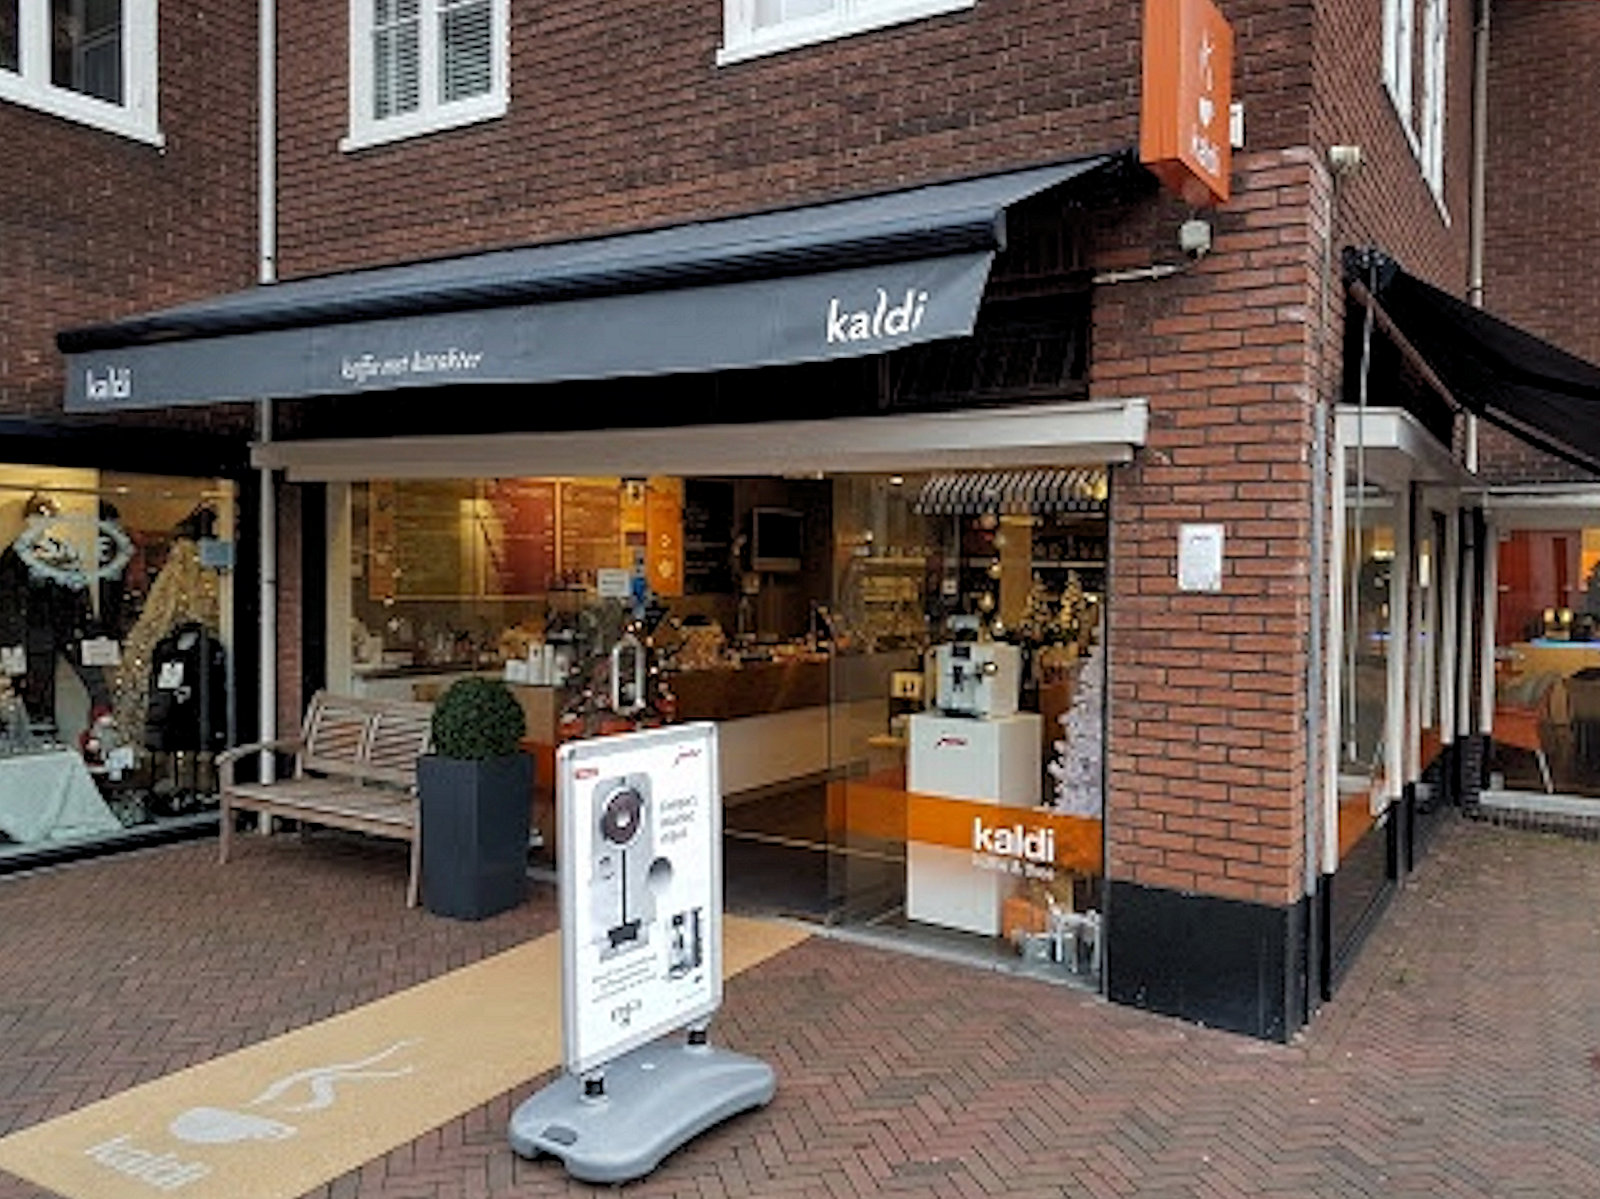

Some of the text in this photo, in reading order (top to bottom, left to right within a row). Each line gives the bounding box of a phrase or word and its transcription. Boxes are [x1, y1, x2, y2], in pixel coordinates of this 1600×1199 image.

[827, 287, 928, 342] kaldi
[85, 366, 132, 400] kaldi
[973, 815, 1055, 862] kaldi
